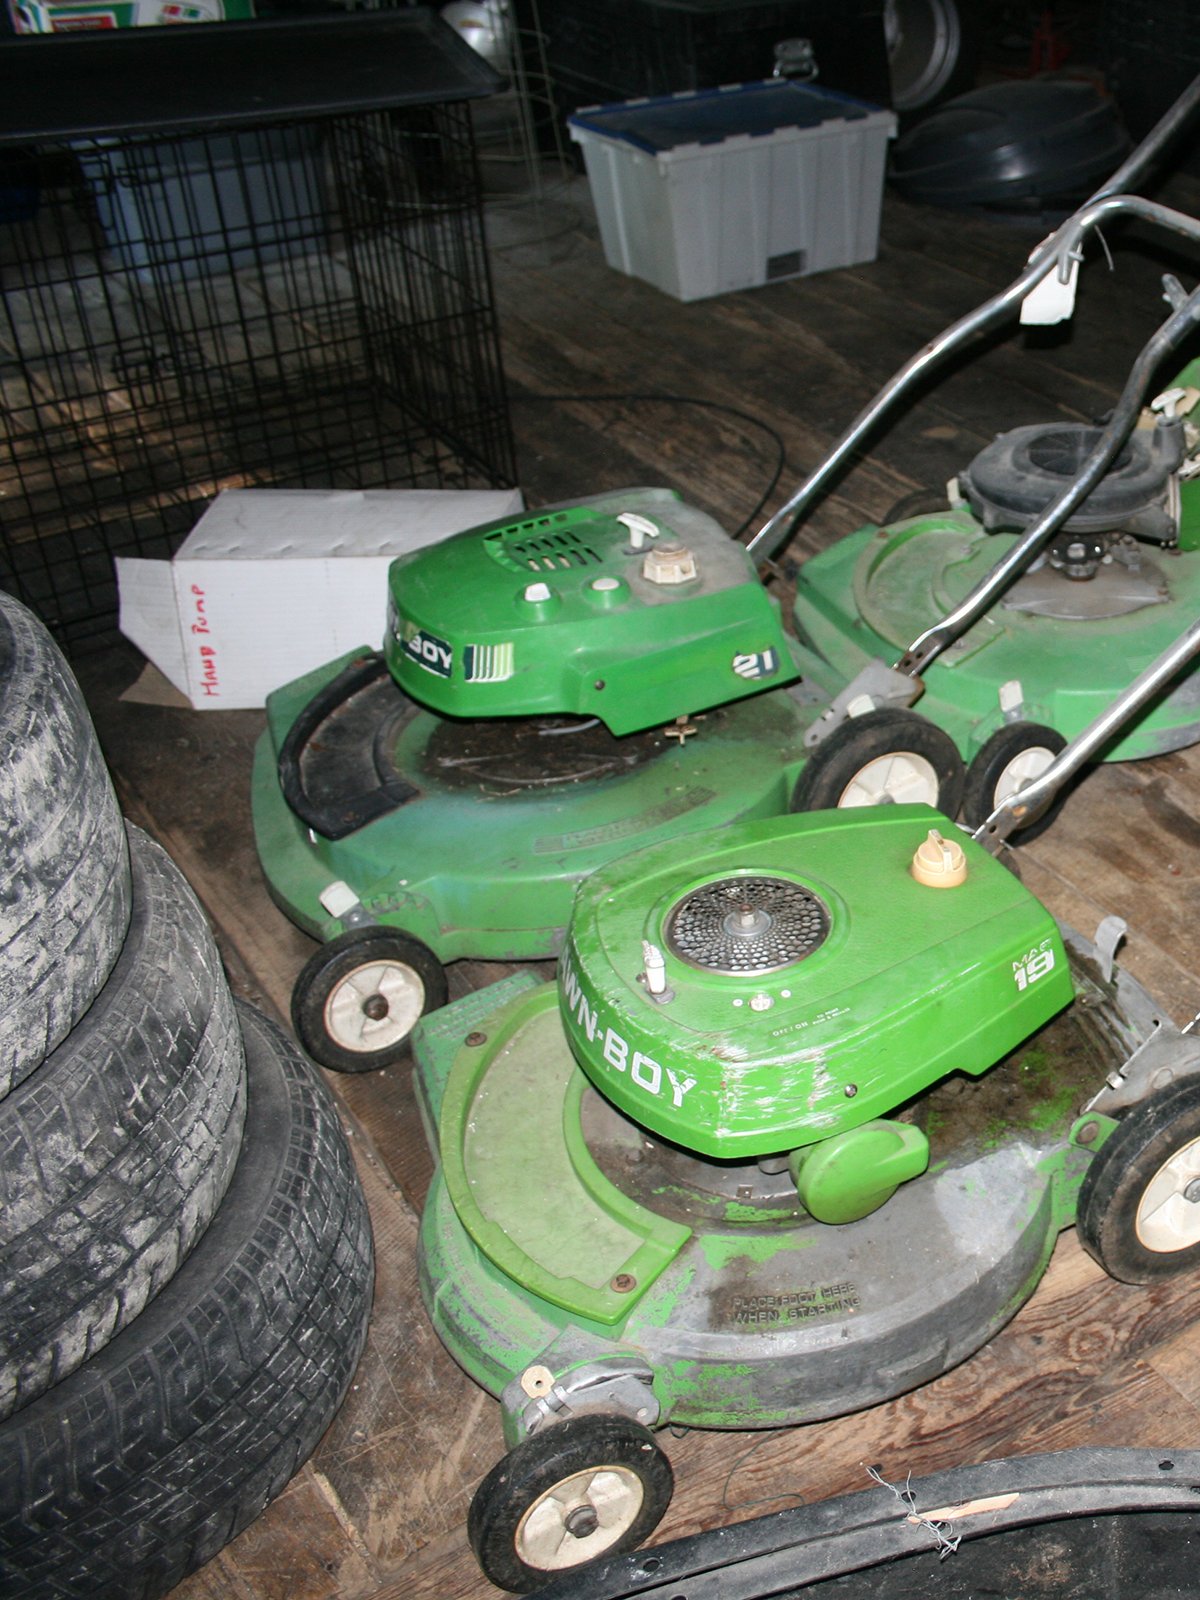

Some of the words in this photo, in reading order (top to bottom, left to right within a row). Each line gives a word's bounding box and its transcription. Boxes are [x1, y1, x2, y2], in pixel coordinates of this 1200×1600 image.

[1014, 948, 1055, 991] 19
[733, 1296, 776, 1310] PLACE
[781, 1293, 816, 1307] FOOT
[735, 1311, 779, 1324] WHEN
[788, 1297, 861, 1319] STARTING
